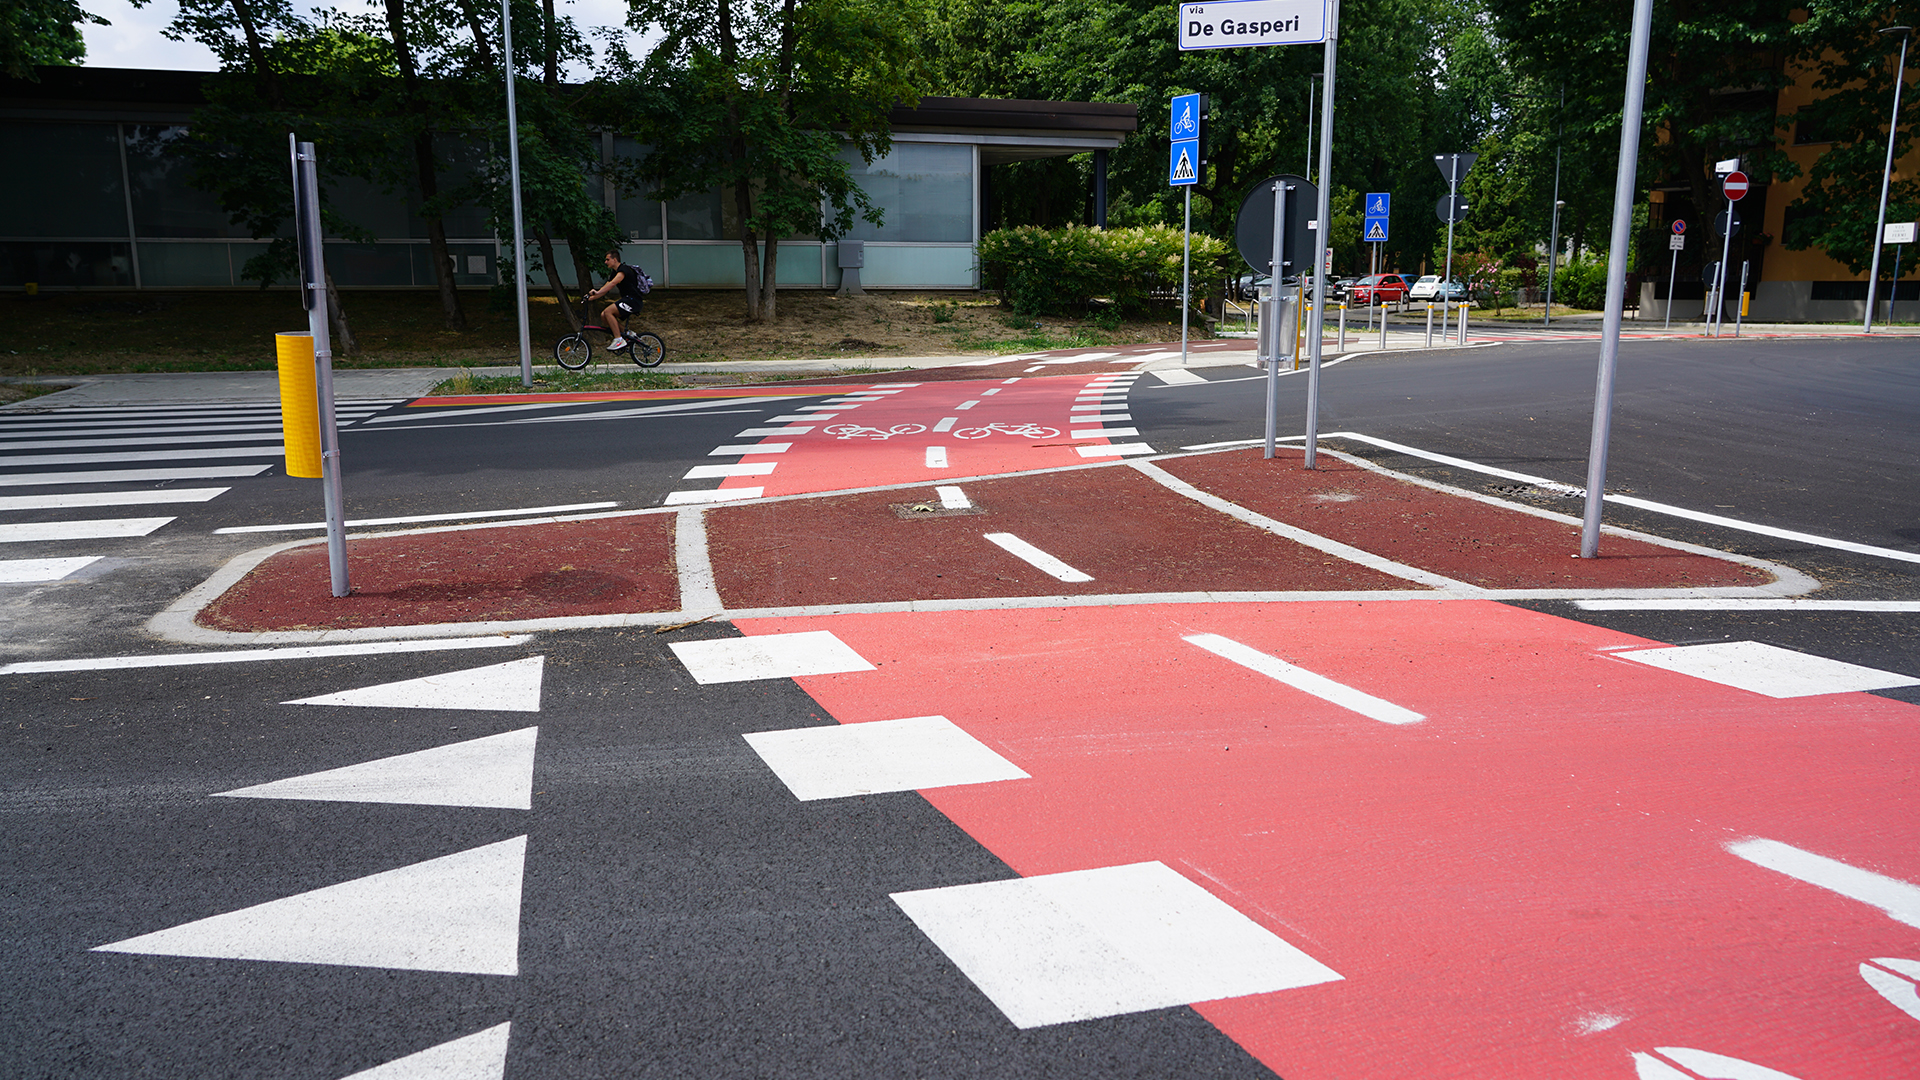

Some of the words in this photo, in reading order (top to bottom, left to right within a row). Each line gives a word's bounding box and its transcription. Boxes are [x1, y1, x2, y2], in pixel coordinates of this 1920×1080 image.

[1189, 5, 1204, 14] via
[1188, 21, 1214, 37] De
[1220, 15, 1300, 37] Gasperi
